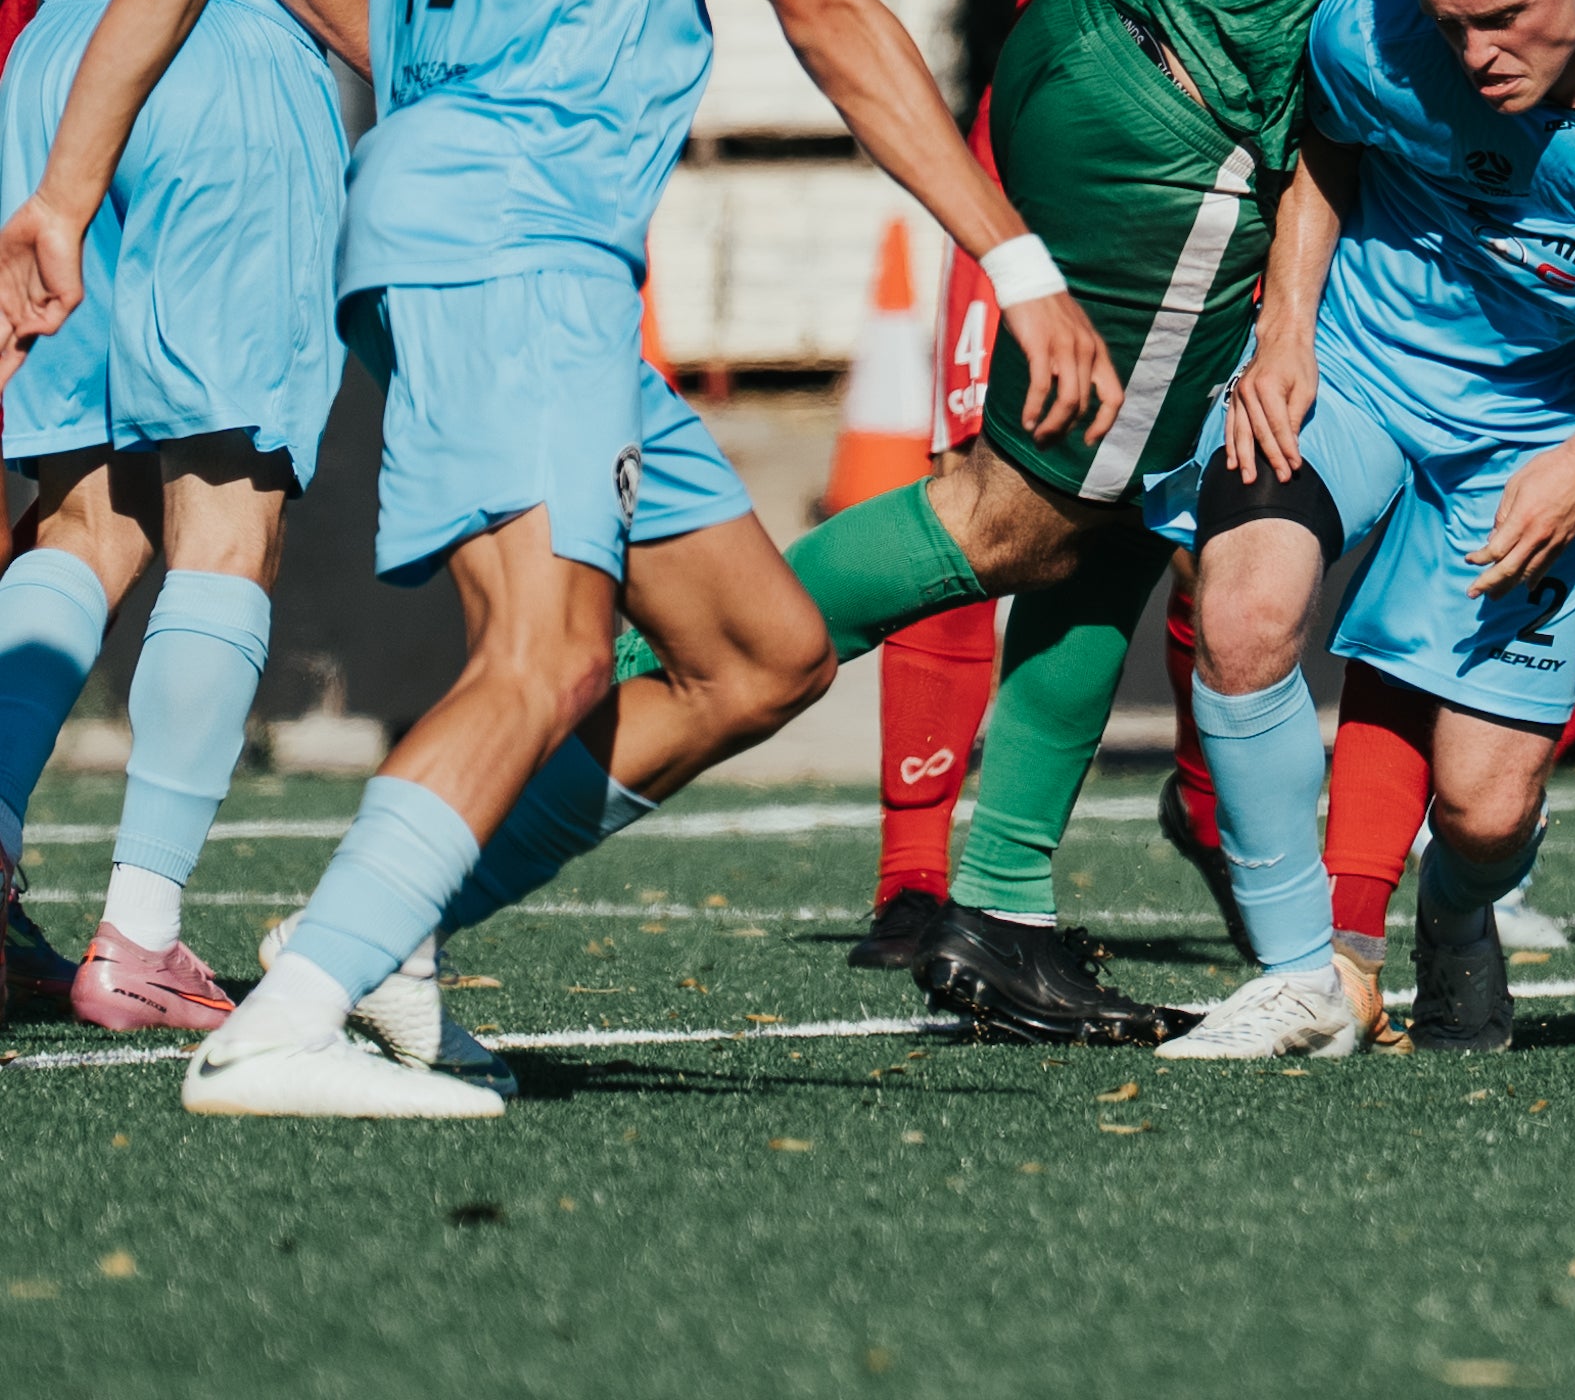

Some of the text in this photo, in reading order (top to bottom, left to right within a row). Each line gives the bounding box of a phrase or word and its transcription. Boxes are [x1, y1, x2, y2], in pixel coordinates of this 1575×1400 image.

[954, 300, 987, 380] 4
[1516, 576, 1568, 648] 2
[1488, 647, 1567, 673] DEPLOY
